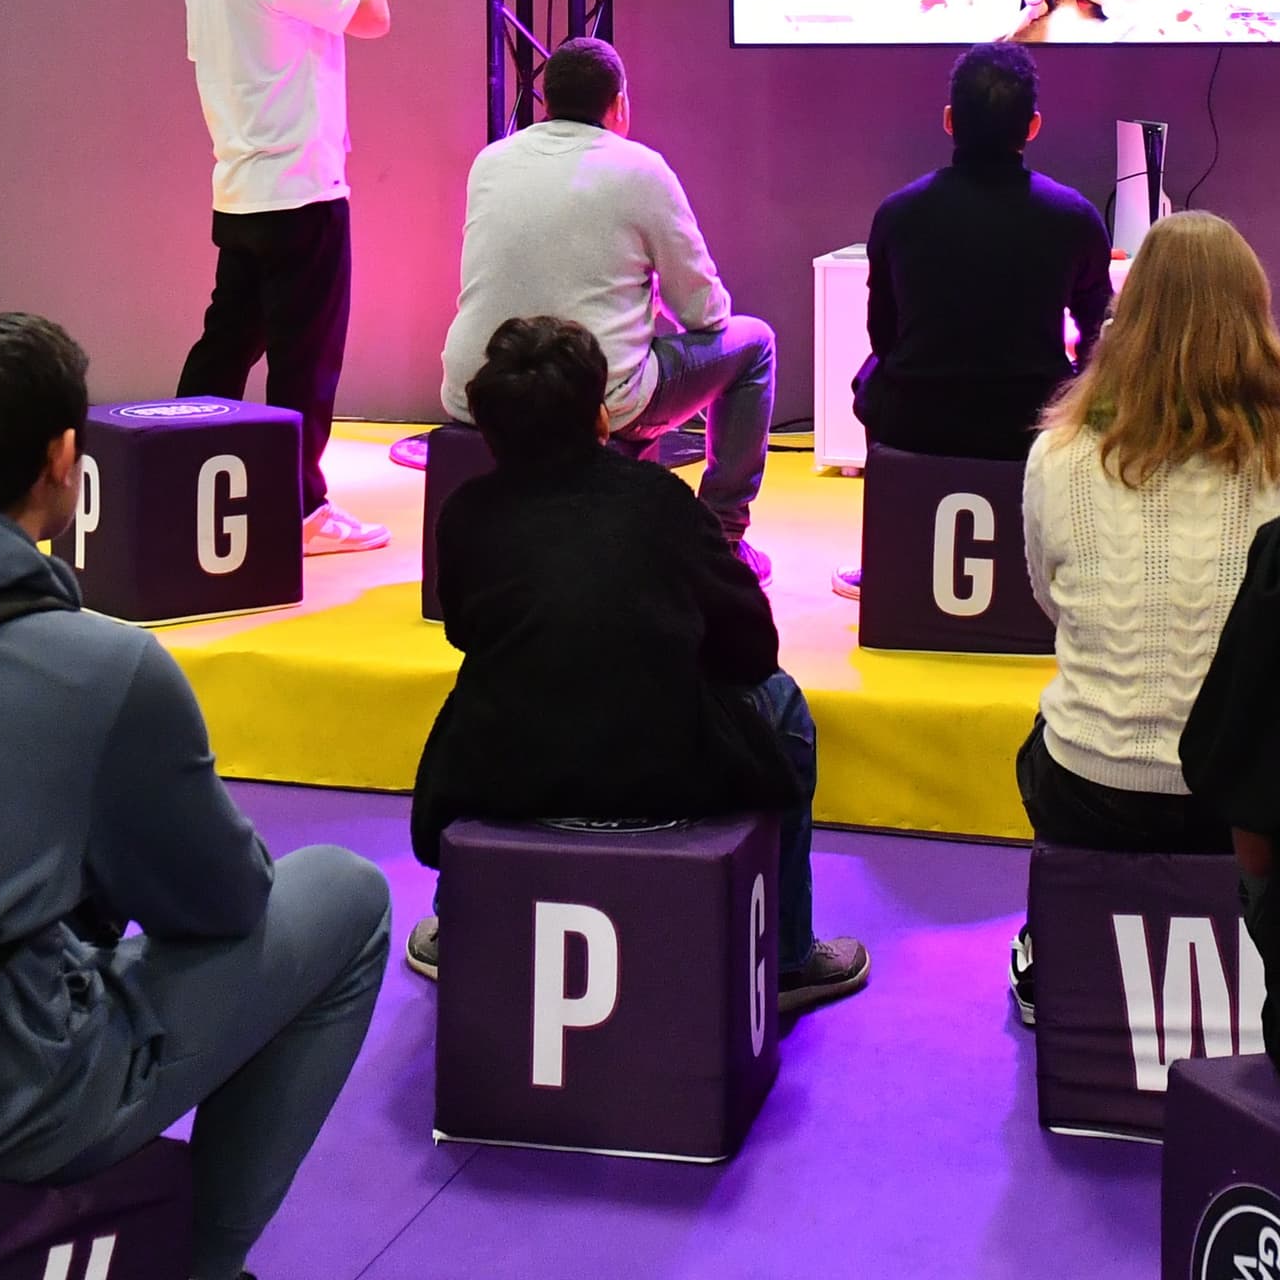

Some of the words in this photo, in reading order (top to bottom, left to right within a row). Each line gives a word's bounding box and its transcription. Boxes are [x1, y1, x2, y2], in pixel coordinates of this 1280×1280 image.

[75, 454, 100, 569] P
[197, 454, 248, 574] G
[933, 492, 995, 616] G
[532, 901, 619, 1086] P
[749, 873, 766, 1058] G
[1113, 914, 1268, 1091] W
